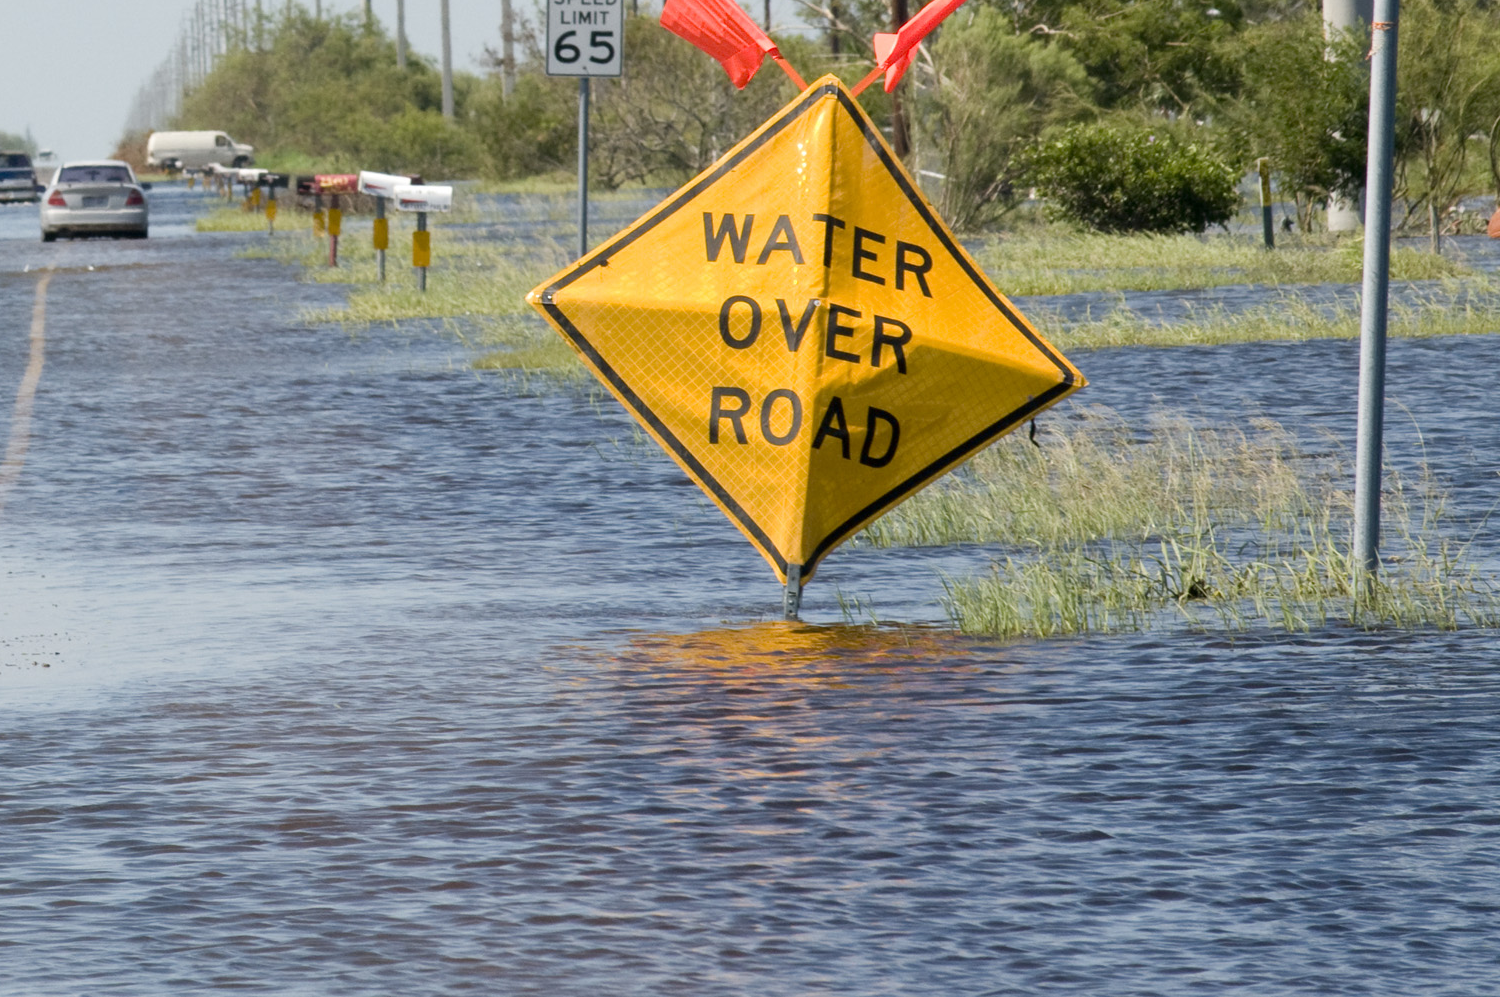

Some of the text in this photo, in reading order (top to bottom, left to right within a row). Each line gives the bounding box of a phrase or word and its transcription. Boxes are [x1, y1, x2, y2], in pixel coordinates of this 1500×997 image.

[554, 30, 615, 65] 65
[560, 10, 610, 25] LIMIT
[702, 211, 933, 299] WATER
[718, 295, 912, 375] OVER
[708, 386, 900, 469] ROAD
